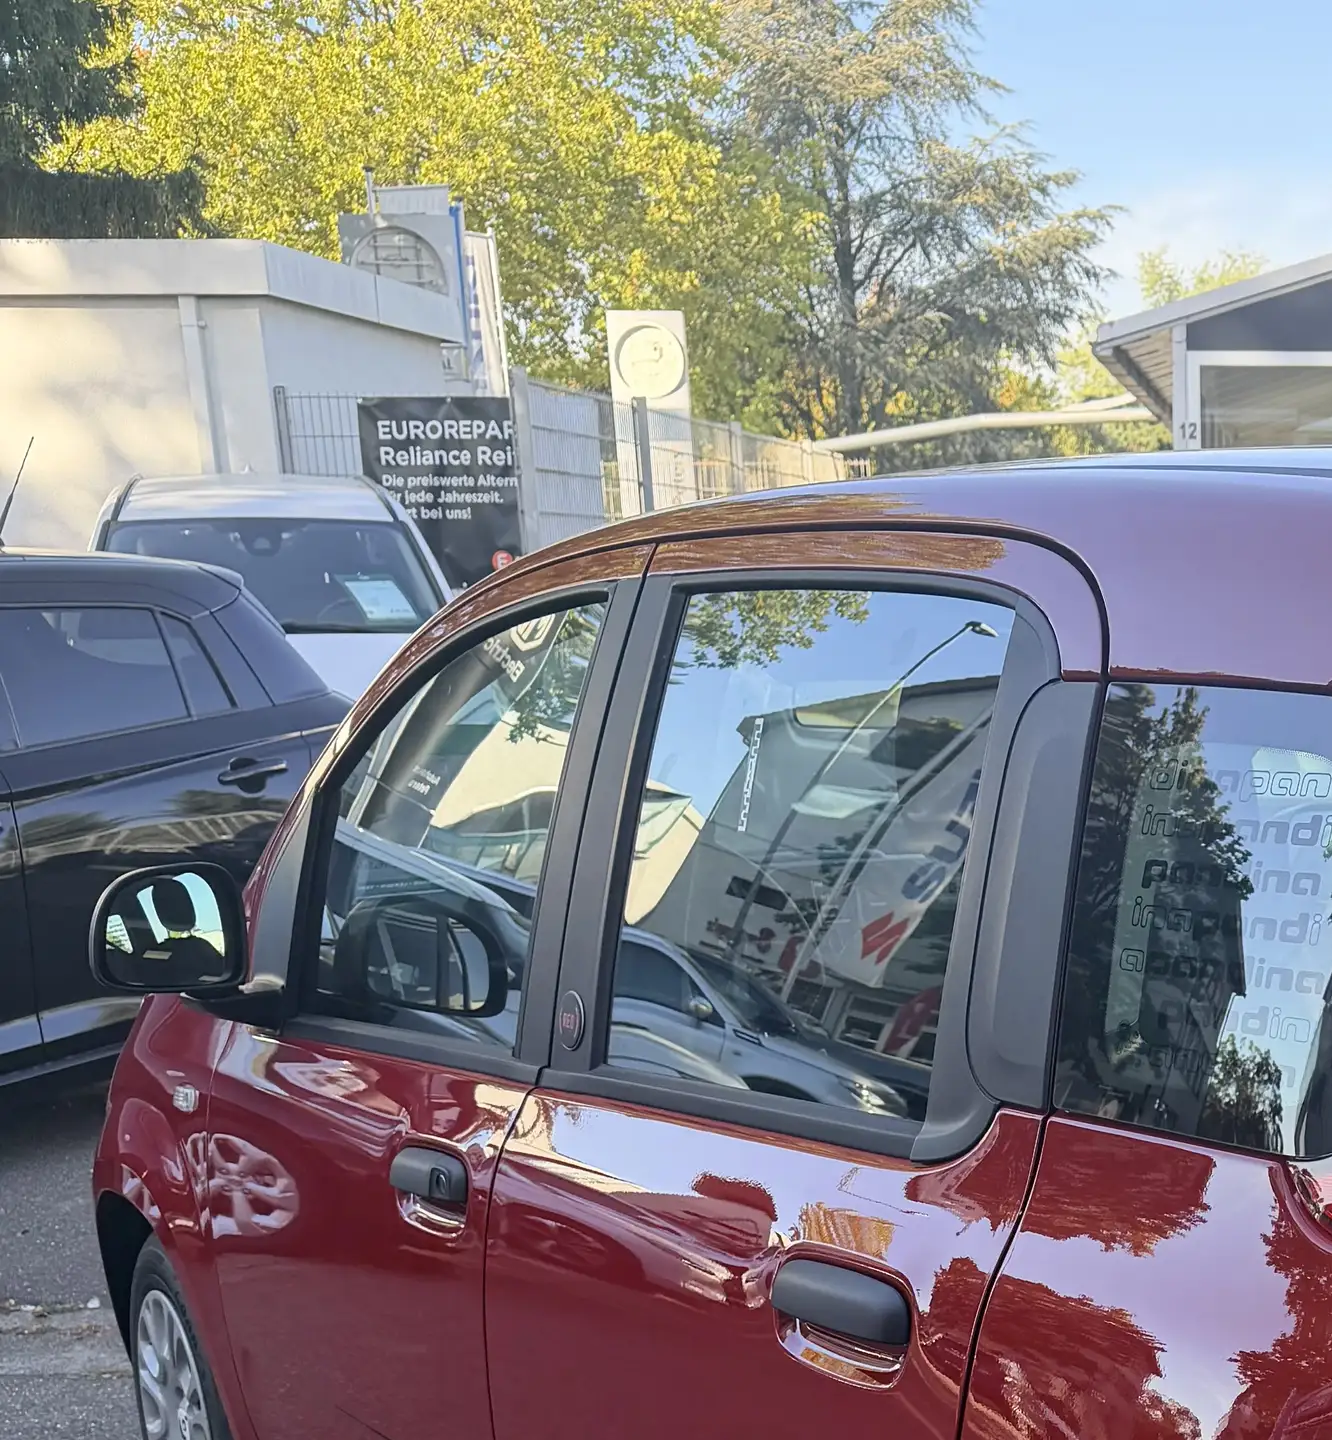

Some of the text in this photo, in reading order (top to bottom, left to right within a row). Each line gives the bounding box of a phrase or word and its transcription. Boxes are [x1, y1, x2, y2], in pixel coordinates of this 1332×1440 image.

[1179, 421, 1197, 440] 12
[380, 445, 515, 467] Reliance Rei
[382, 474, 404, 487] Die
[407, 473, 475, 489] preiswerte
[404, 490, 434, 505] jede
[421, 506, 443, 519] bei
